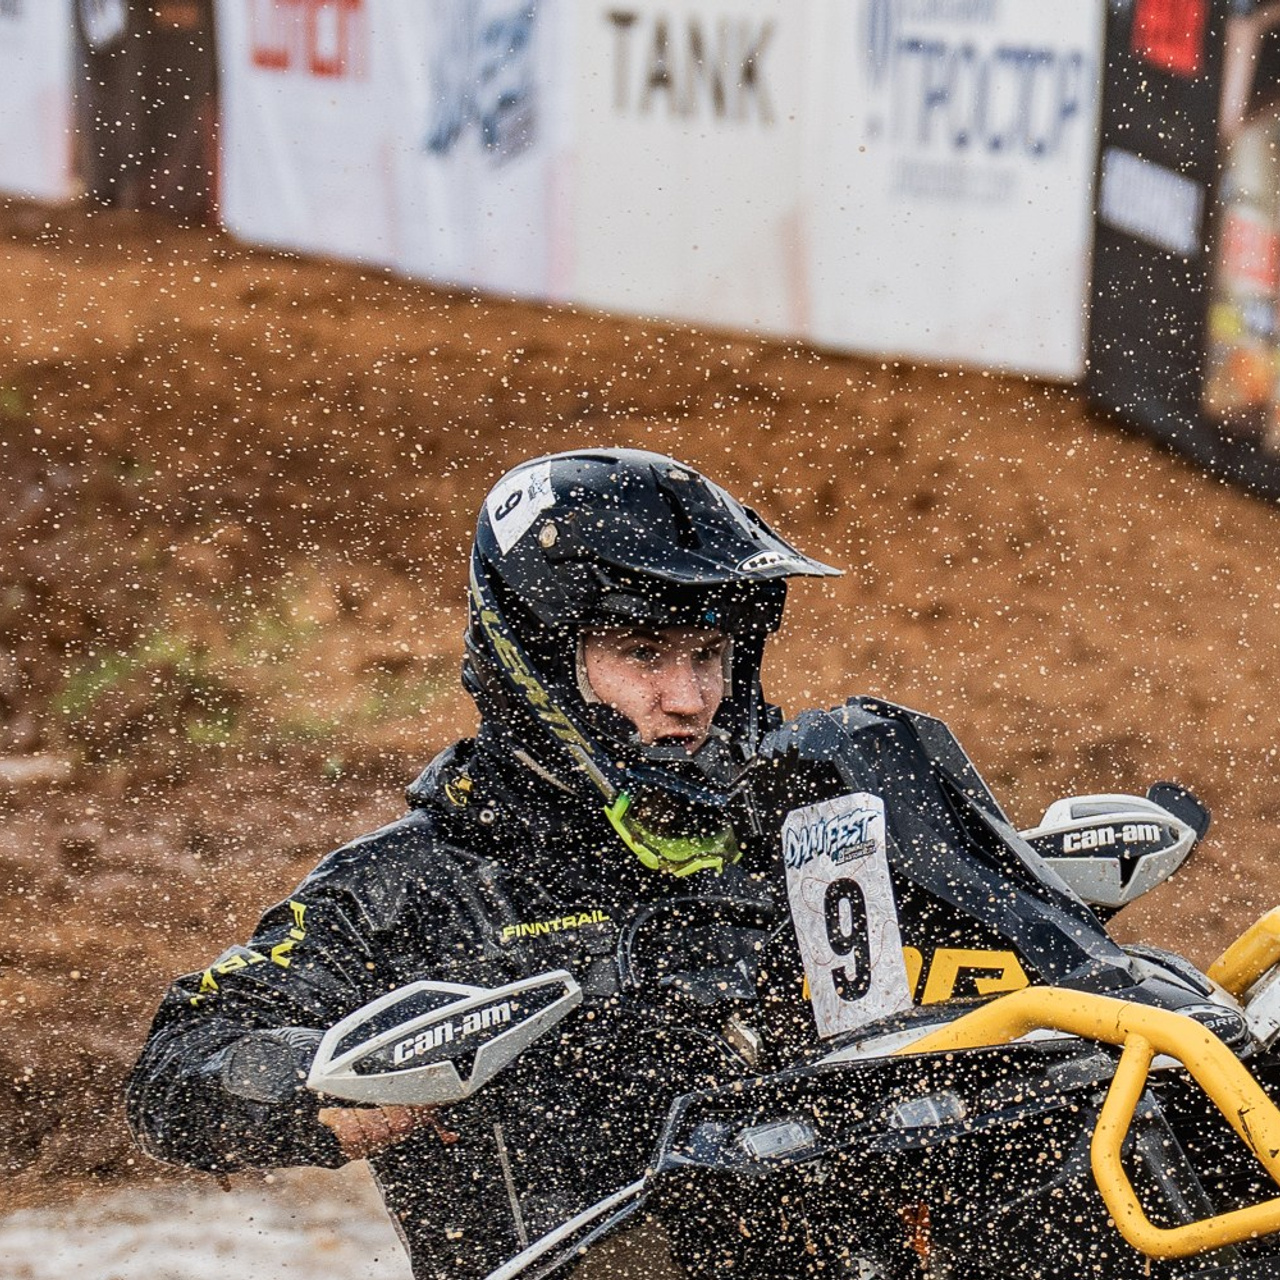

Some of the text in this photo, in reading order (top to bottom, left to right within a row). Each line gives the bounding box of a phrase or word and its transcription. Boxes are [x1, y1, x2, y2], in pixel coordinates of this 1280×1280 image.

[606, 12, 777, 126] TANK
[495, 489, 523, 522] 9
[502, 909, 610, 939] FINNTRAIL
[824, 876, 871, 1003] 9
[1203, 1016, 1239, 1029] BRP
